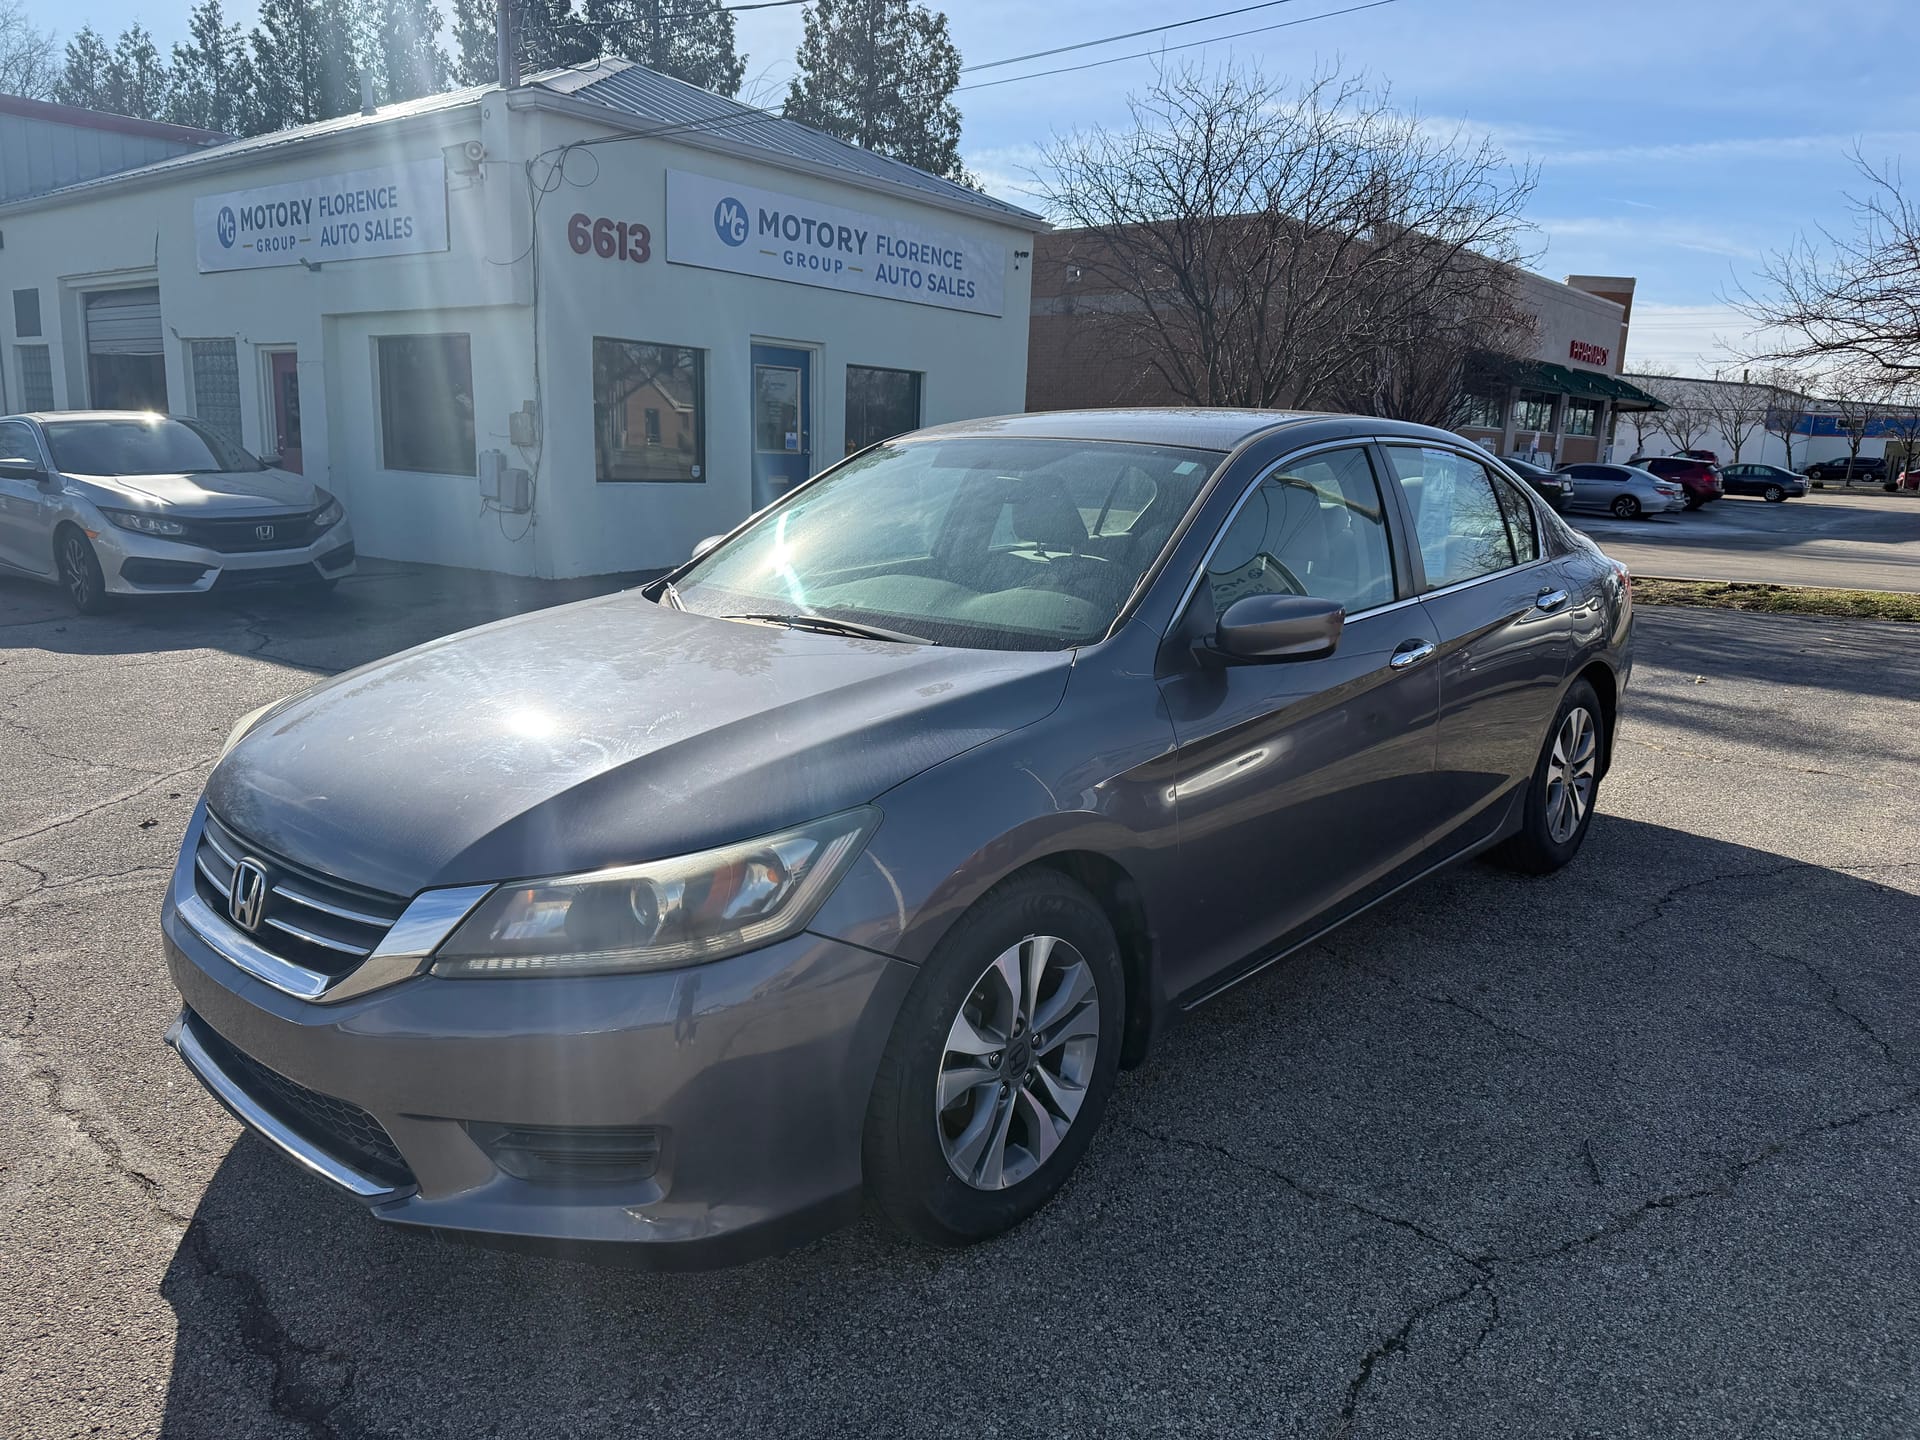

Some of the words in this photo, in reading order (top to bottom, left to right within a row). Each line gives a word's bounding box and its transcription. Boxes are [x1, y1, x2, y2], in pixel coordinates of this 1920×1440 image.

[240, 198, 313, 232] MOTORY
[319, 186, 398, 218] FLORENCE
[256, 235, 296, 252] GROUP
[320, 223, 360, 248] AUTO
[364, 216, 413, 242] SALES
[567, 213, 651, 264] 6613
[758, 208, 868, 256] MOTORY
[783, 250, 843, 274] GROUP
[876, 235, 963, 271] FLORENCE
[875, 263, 923, 289] AUTO
[927, 273, 976, 299] SALES
[1570, 340, 1609, 365] PHARMACY
